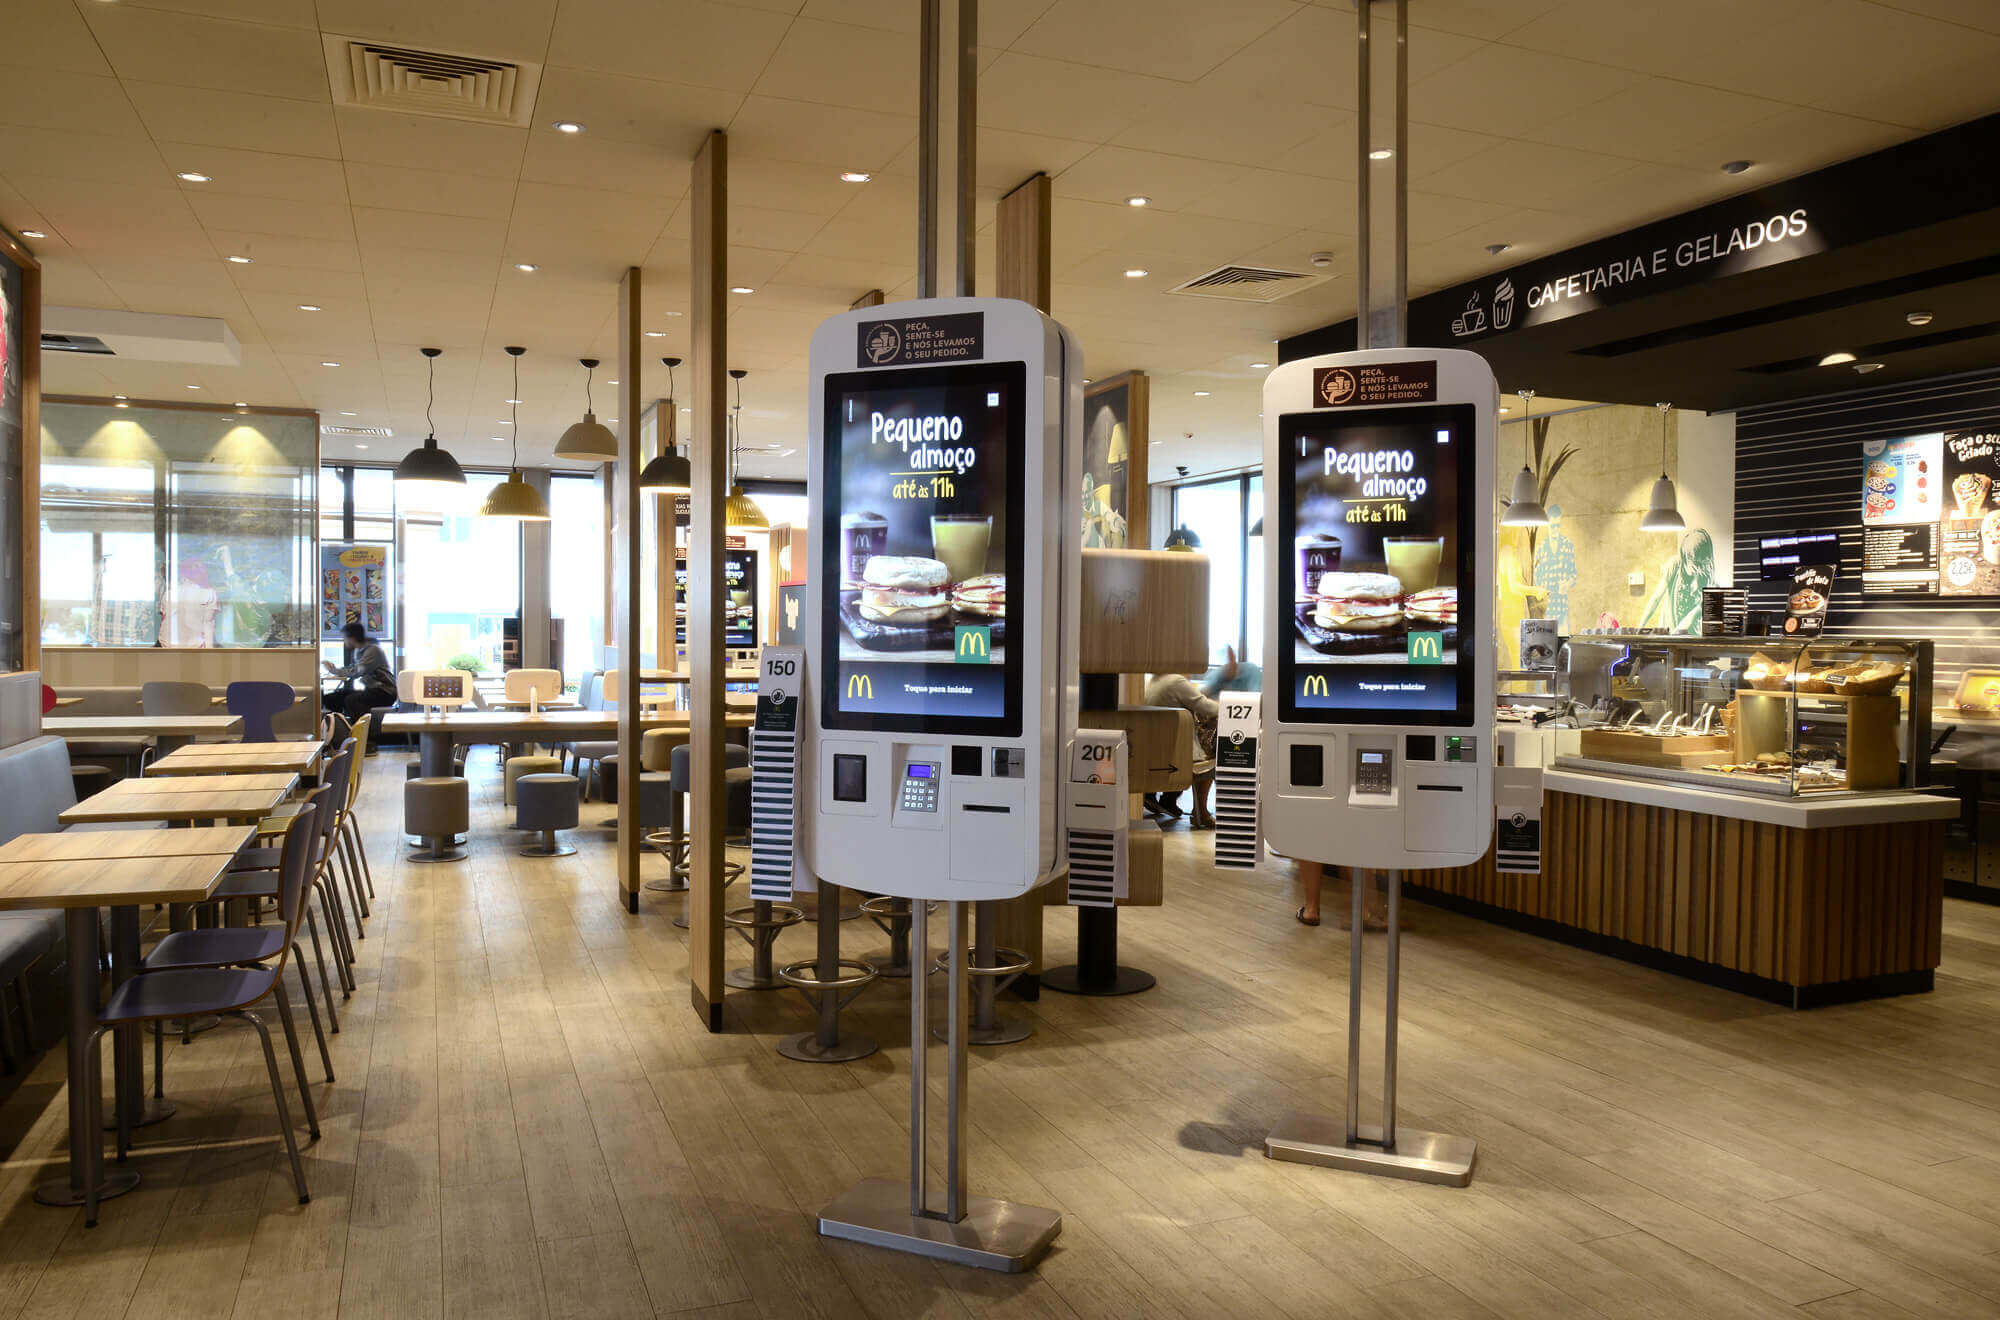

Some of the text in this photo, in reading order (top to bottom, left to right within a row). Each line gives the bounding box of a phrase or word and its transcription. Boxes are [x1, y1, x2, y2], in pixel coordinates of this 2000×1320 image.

[1527, 209, 1807, 309] CAFETARIA E GELADOS
[905, 330, 945, 340] SENTE-SE
[905, 337, 976, 350] E NÓS LEVAMOS
[914, 350, 931, 359] SEU
[934, 348, 969, 358] PEDIDO.
[1360, 376, 1400, 384] SENTE-SE
[1368, 383, 1386, 392] NÓS
[1388, 382, 1429, 391] LEVAMOS
[1370, 392, 1386, 400] SEU
[1388, 391, 1423, 400] PEDIDO.
[872, 412, 962, 452] Pequeno
[910, 442, 976, 474] almoço
[1324, 447, 1414, 482] Pequeno
[892, 476, 954, 499] até às 11h
[1362, 474, 1426, 501] almoço
[1346, 504, 1406, 522] até às 11h
[767, 660, 796, 676] 150
[904, 684, 974, 694] Toque para iniciar
[1358, 682, 1382, 691] Toque
[1226, 705, 1252, 719] 127
[1081, 744, 1112, 761] 201
